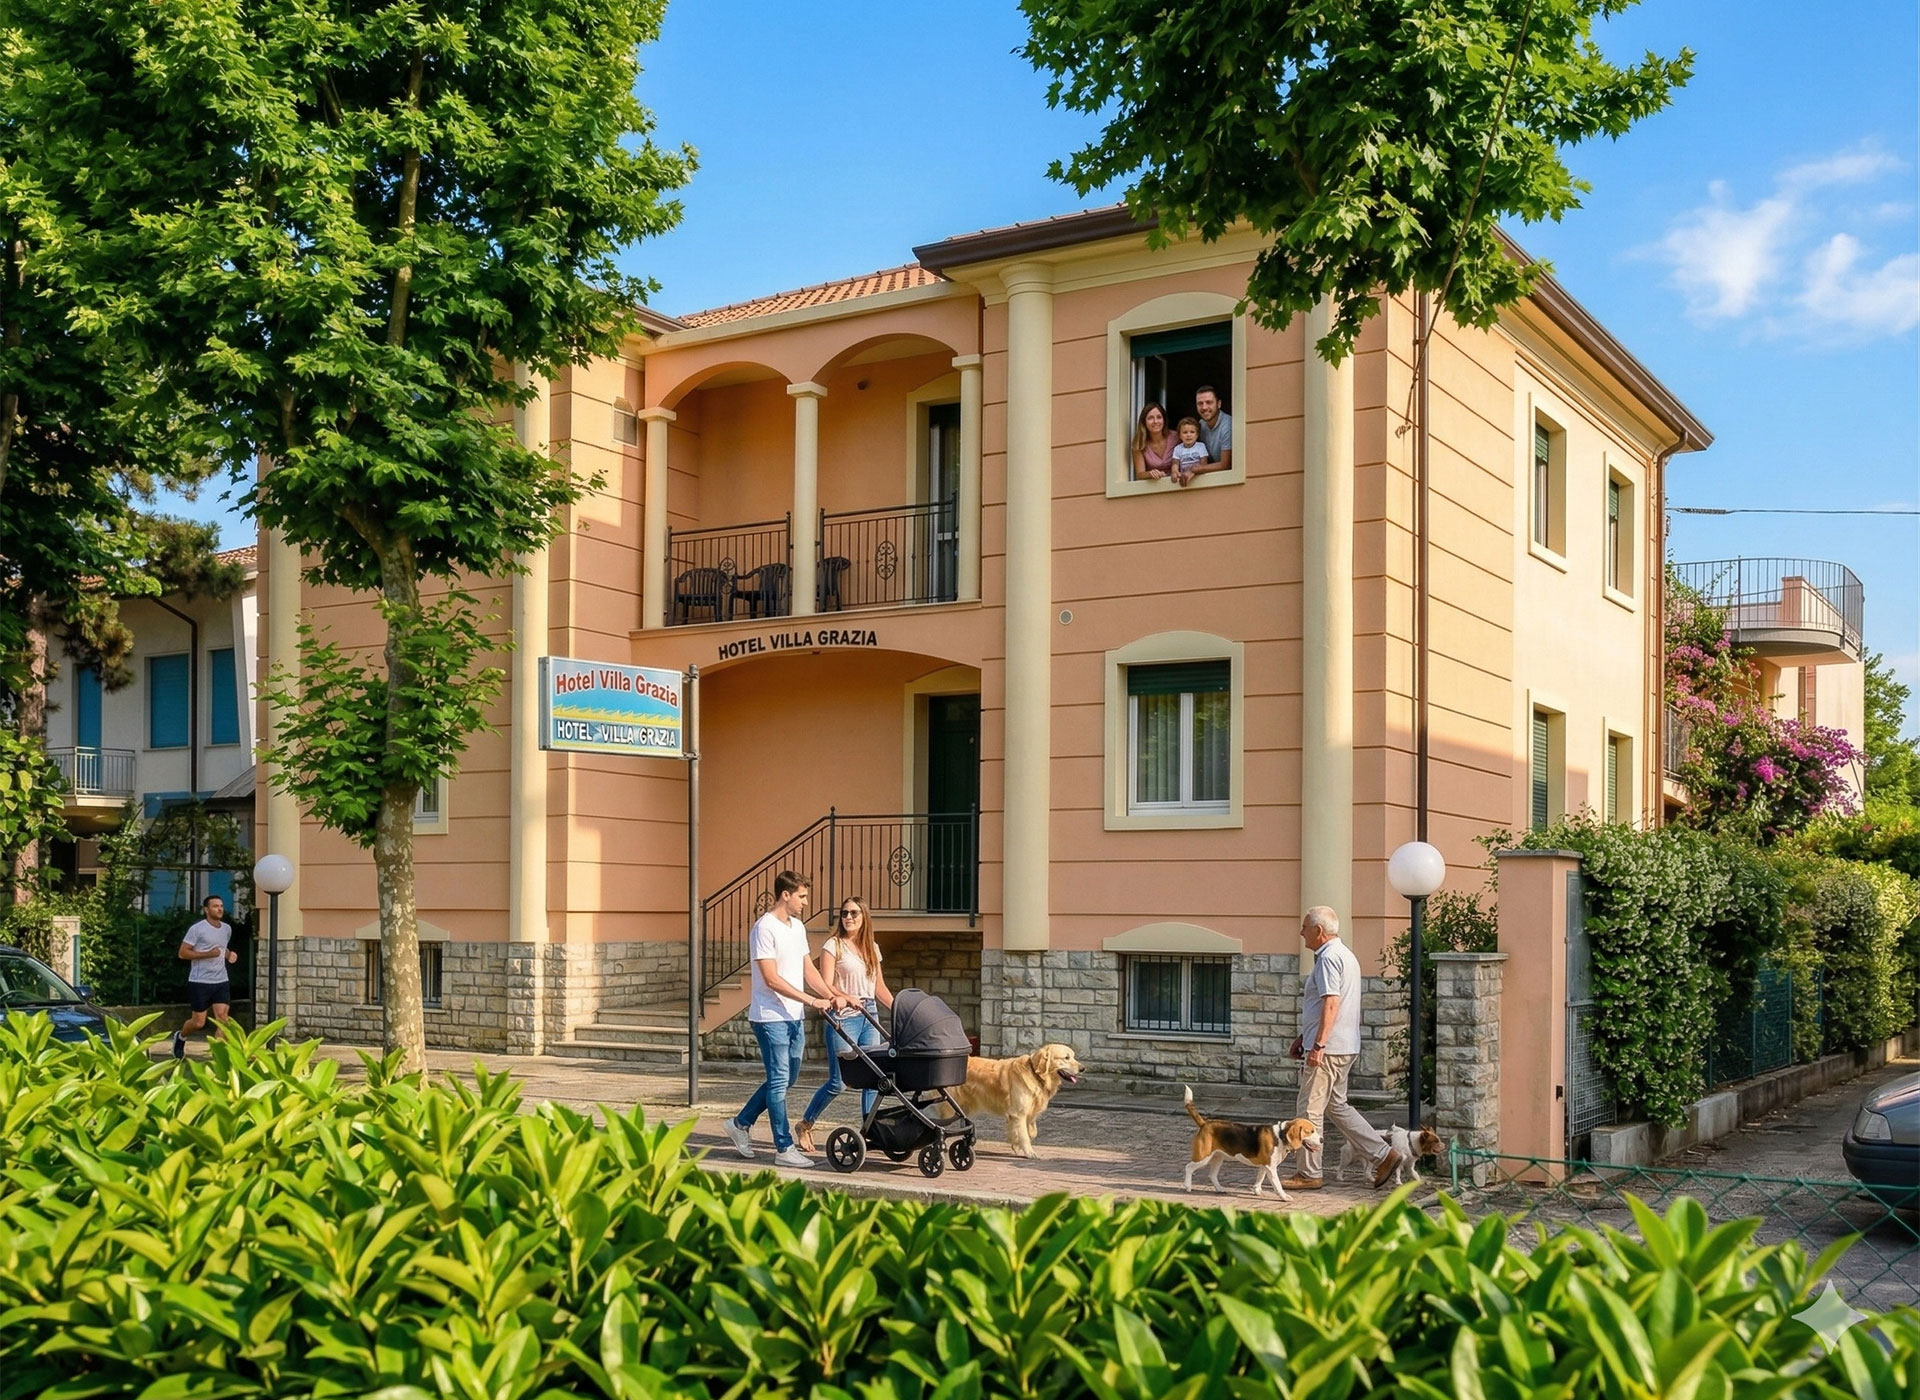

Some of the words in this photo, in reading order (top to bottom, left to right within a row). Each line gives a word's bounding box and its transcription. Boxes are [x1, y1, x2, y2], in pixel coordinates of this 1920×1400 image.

[718, 637, 766, 660] HOTEL
[770, 631, 813, 649] VILLA
[818, 630, 877, 646] GRAZIA
[556, 670, 595, 694] Hotel
[600, 670, 631, 691] Villa
[635, 675, 678, 707] Grazia
[557, 720, 593, 741] HOTEL
[601, 724, 634, 744] VILLA
[639, 727, 676, 747] GRAZIA
